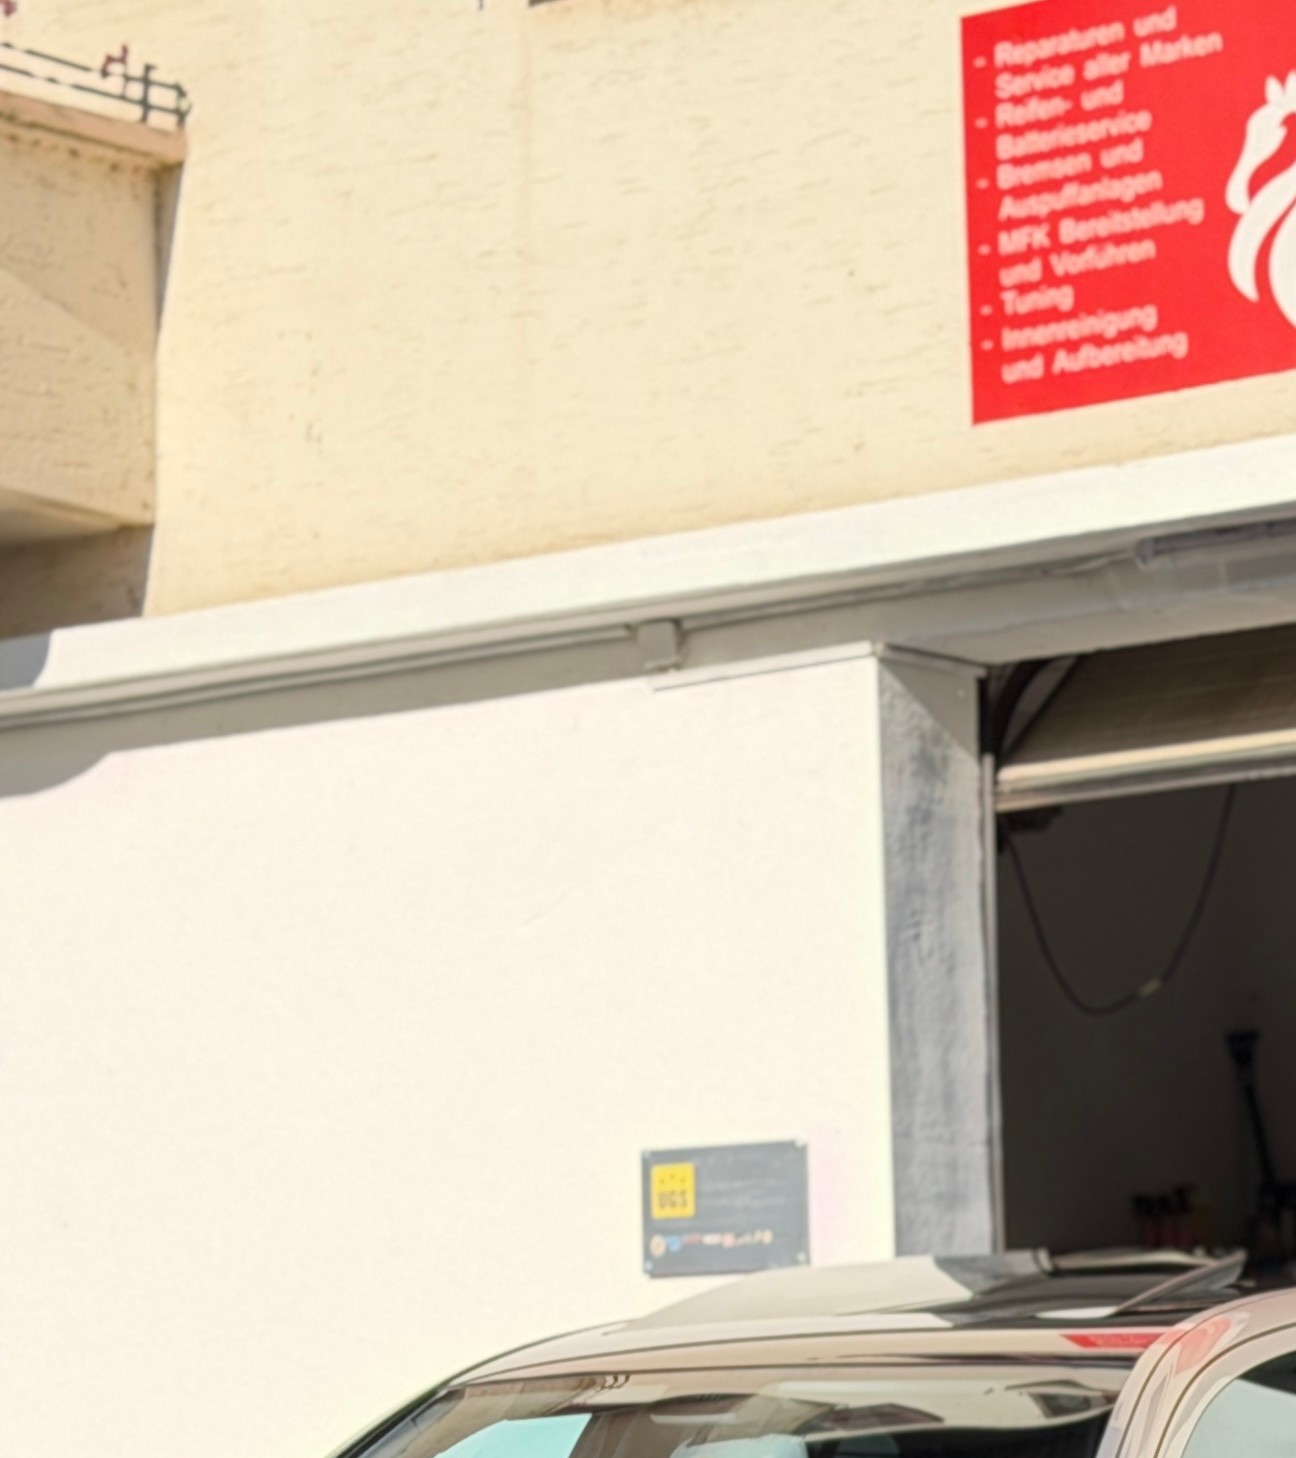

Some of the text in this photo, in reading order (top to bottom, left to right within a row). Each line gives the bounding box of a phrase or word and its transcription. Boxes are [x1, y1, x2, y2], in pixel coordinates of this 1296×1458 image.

[993, 5, 1177, 67] Reparaturen und
[995, 32, 1224, 99] Service aller Marken
[1081, 80, 1124, 110] und
[996, 110, 1152, 160] Batterieservice
[997, 138, 1144, 190] Bremsen und
[999, 170, 1163, 220] Auspuffanlagen
[998, 198, 1204, 256] MFK Bereitstellung
[999, 257, 1042, 287] und
[1000, 285, 1074, 315] Tuning
[1002, 305, 1158, 350] Innenreinigung
[1002, 332, 1188, 384] und Aufbereitung
